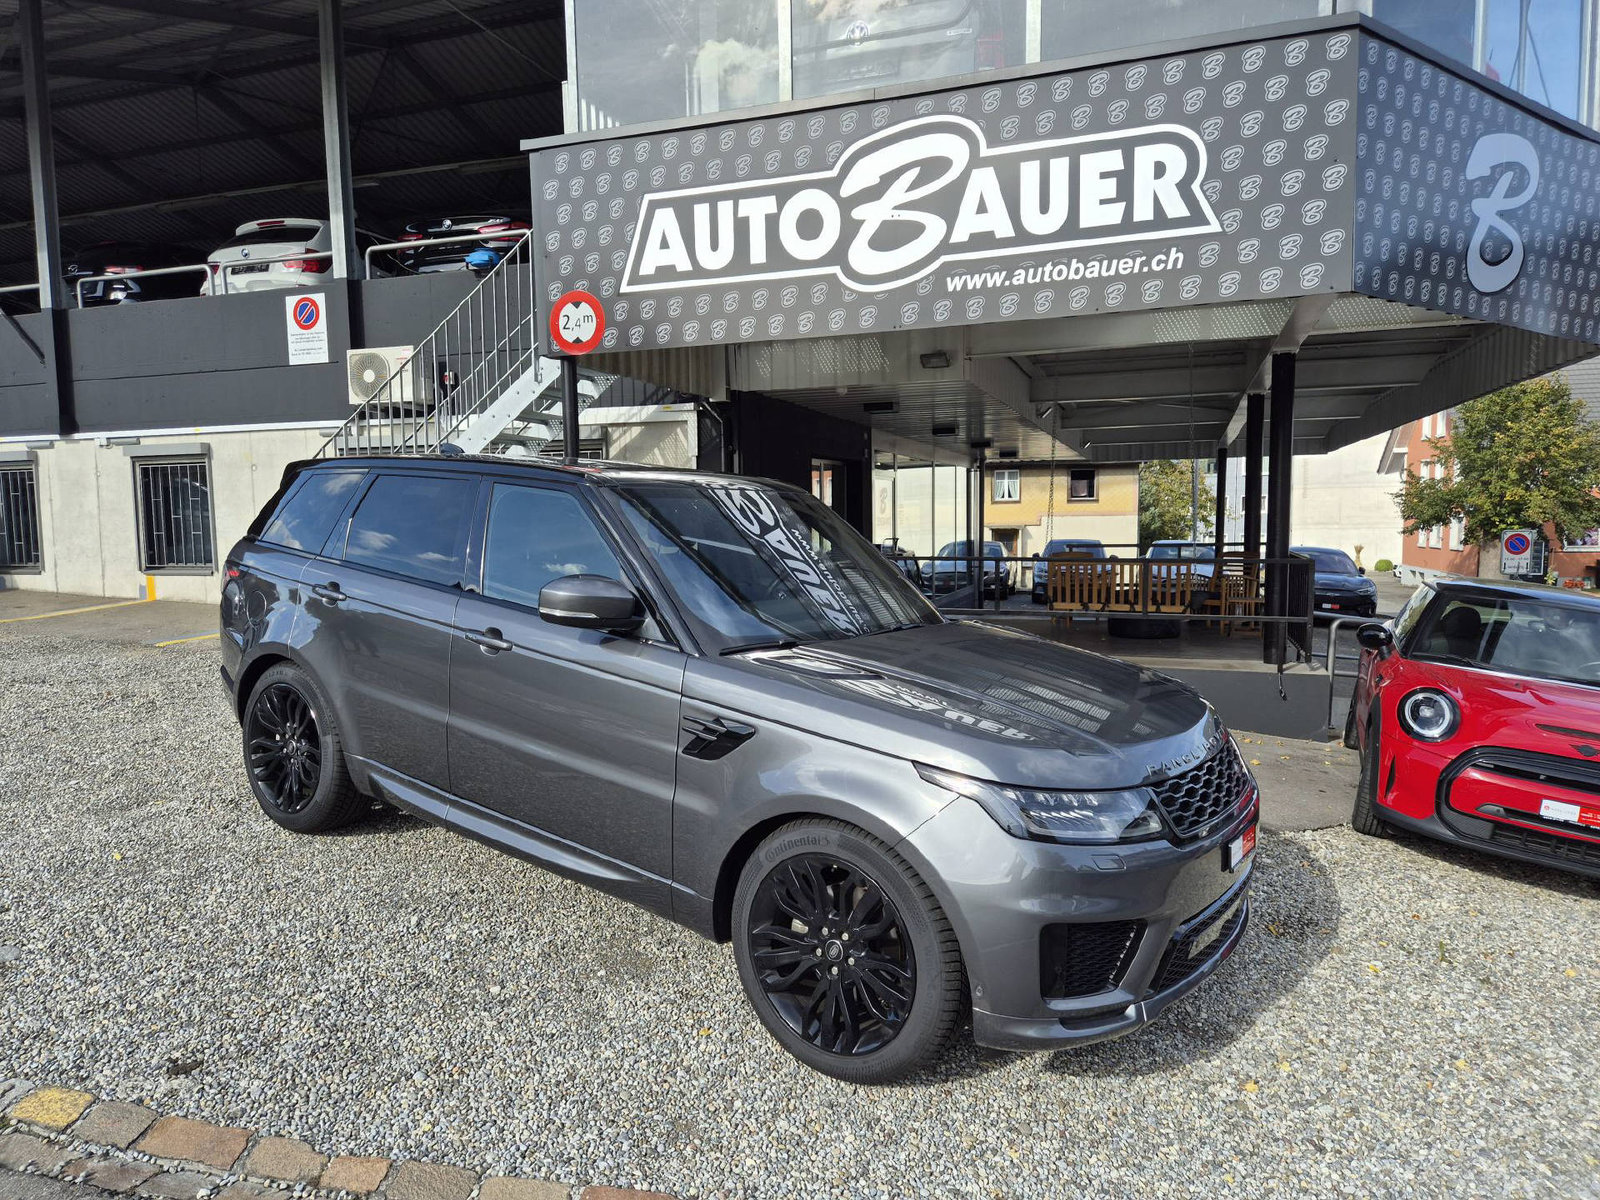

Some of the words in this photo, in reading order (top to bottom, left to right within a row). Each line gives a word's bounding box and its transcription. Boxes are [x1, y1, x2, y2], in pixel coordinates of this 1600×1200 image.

[639, 188, 841, 276] AUTO
[840, 132, 1191, 276] BAUER
[946, 247, 1185, 293] www.autobauer.ch
[764, 834, 821, 862] Continental
